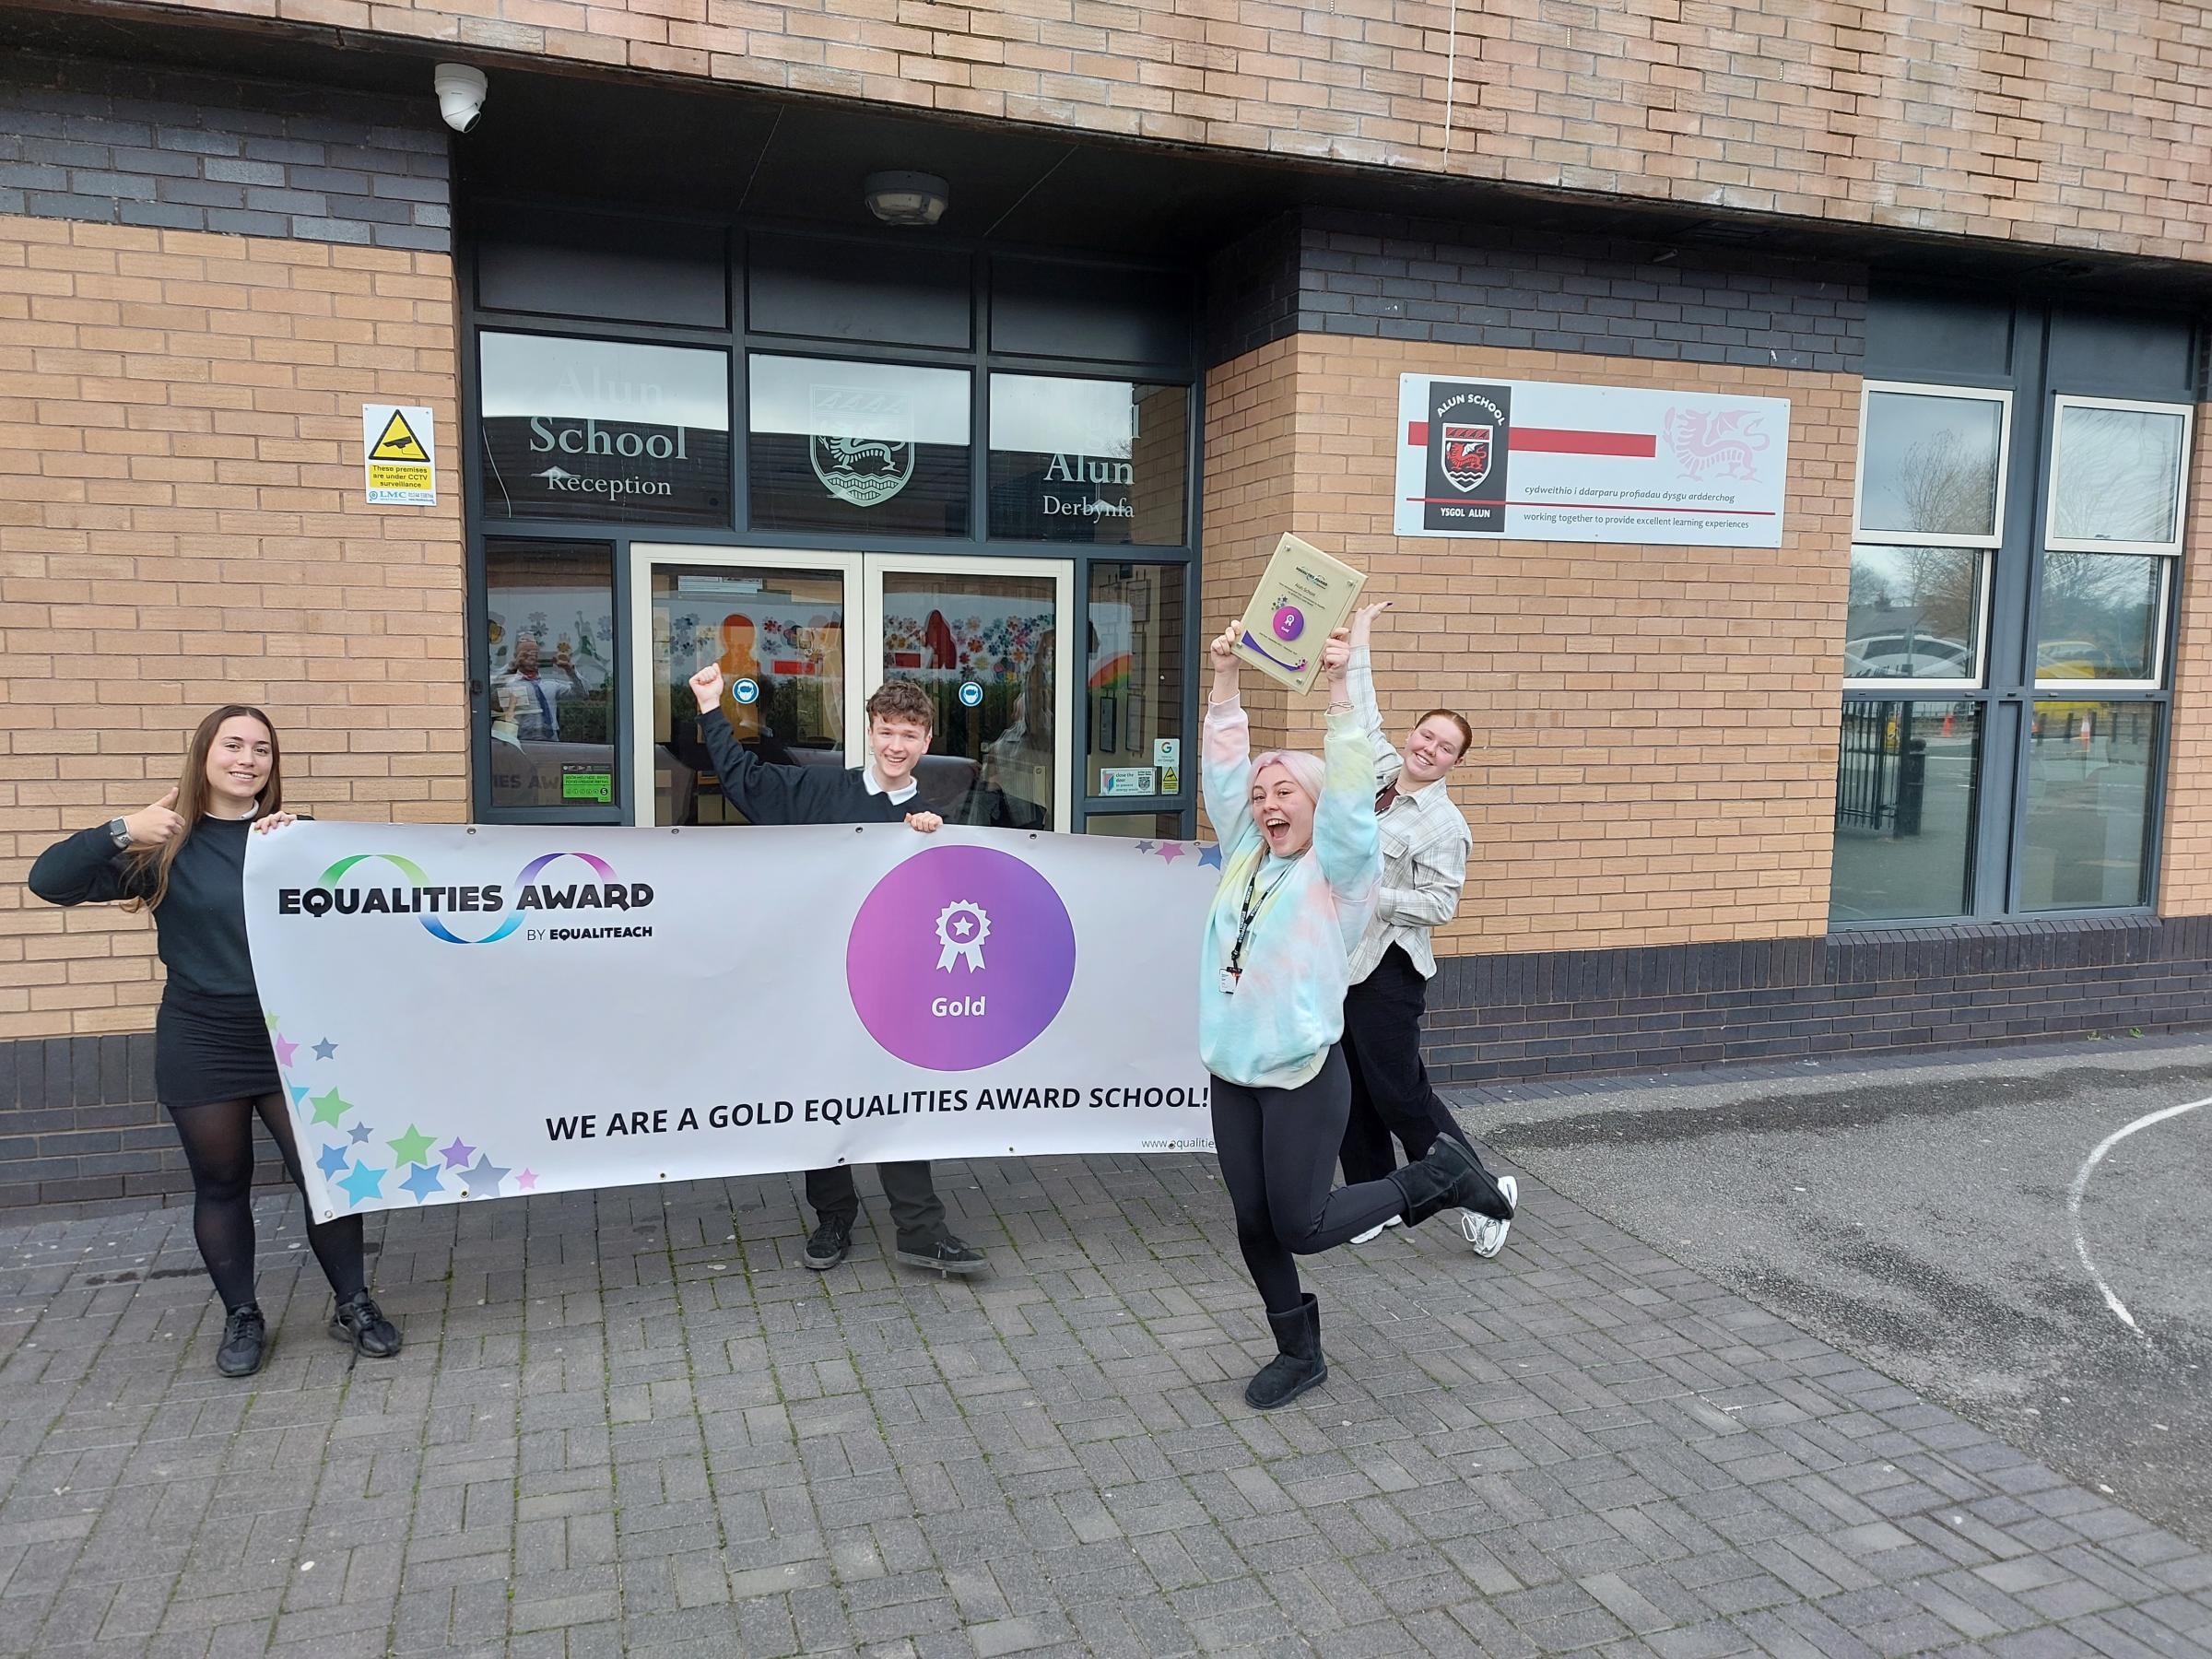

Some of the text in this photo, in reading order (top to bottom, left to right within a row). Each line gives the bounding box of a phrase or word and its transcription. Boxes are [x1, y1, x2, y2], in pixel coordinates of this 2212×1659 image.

[1437, 394, 1505, 426] ALUN SCHOOL
[530, 415, 688, 460] School
[1043, 451, 1135, 485] Alun
[547, 470, 673, 501] Reception
[1524, 485, 1572, 495] cydweithio
[1579, 487, 1618, 499] ddarparu
[1620, 488, 1661, 500] profiadau
[1663, 490, 1687, 502] dysgu
[1688, 491, 1735, 504] ardderchog
[1042, 495, 1135, 524] Derbynfa
[1441, 507, 1491, 518] YSGOL ALUN
[1524, 512, 1749, 530] working together to provide excellent learning experiences
[278, 883, 654, 917] EQUALITIES AWARD
[527, 925, 653, 941] BY EQUALITEACH
[931, 995, 986, 1017] Gold
[546, 1087, 1209, 1141] WE ARE A GOLD EQUALITIES AWARD SCHOOL!
